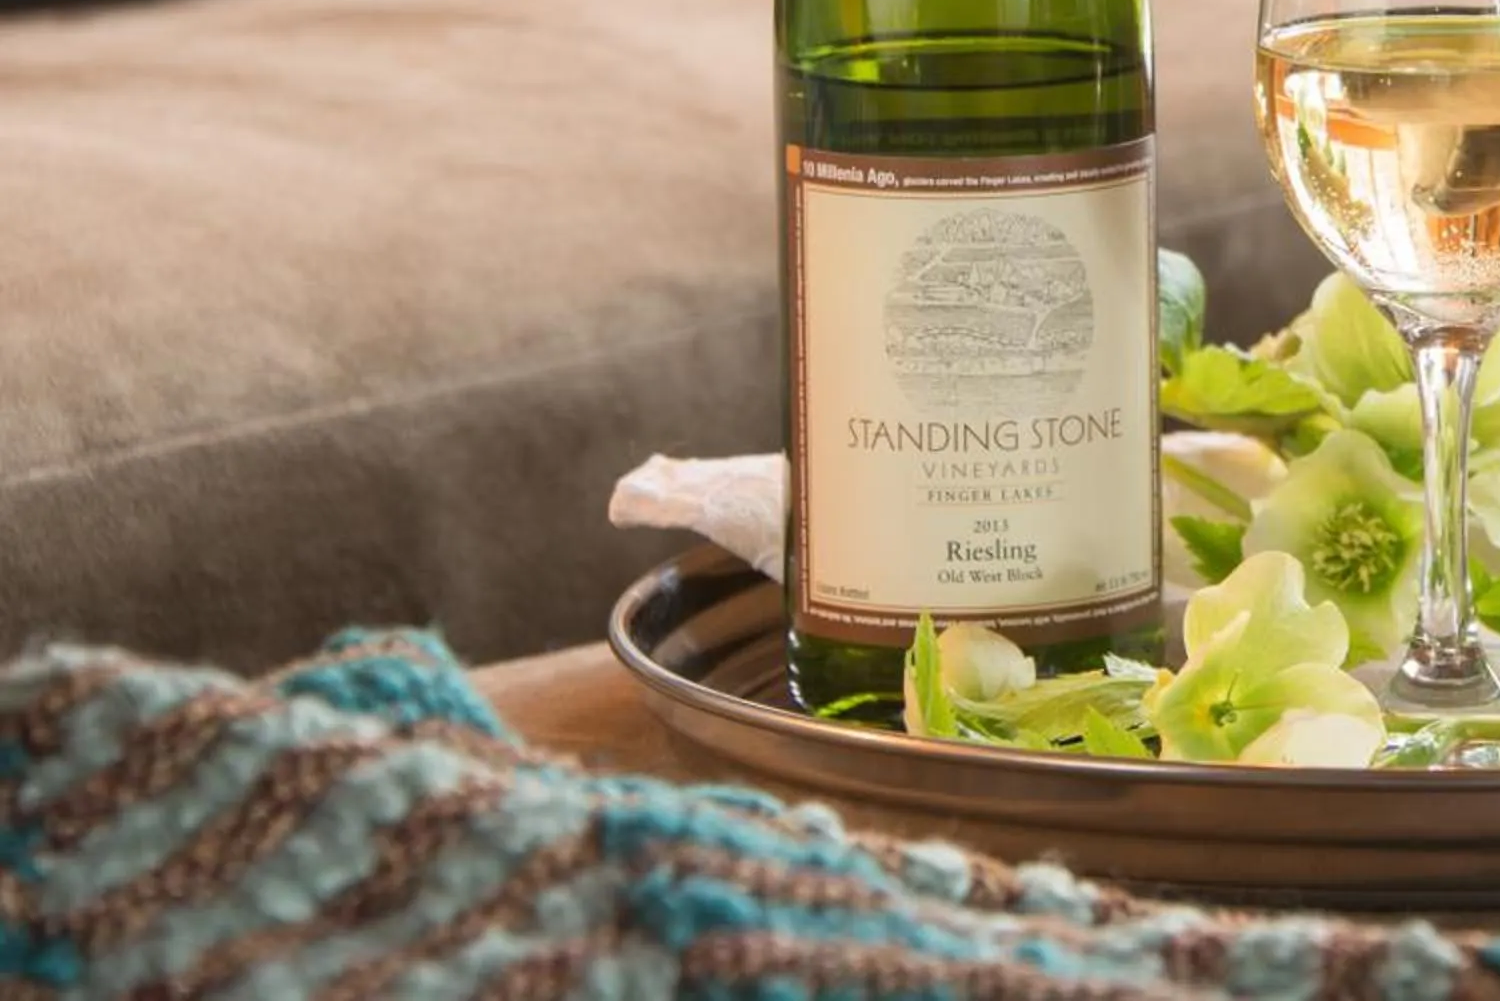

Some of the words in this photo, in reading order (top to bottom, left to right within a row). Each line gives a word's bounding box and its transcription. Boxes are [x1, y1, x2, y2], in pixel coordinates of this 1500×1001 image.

[803, 160, 815, 178] 10
[816, 162, 864, 184] Millenia
[866, 167, 899, 188] Ago,
[847, 417, 1020, 453] STANDING
[1031, 407, 1124, 449] STONE
[921, 456, 1061, 480] VINEYARDS
[927, 488, 992, 502] FINGER
[1001, 485, 1055, 501] LAKES
[972, 518, 1009, 534] 2013
[946, 538, 1038, 564] Riesling
[937, 568, 964, 584] Old
[969, 569, 1003, 583] West
[1006, 565, 1044, 582] Block
